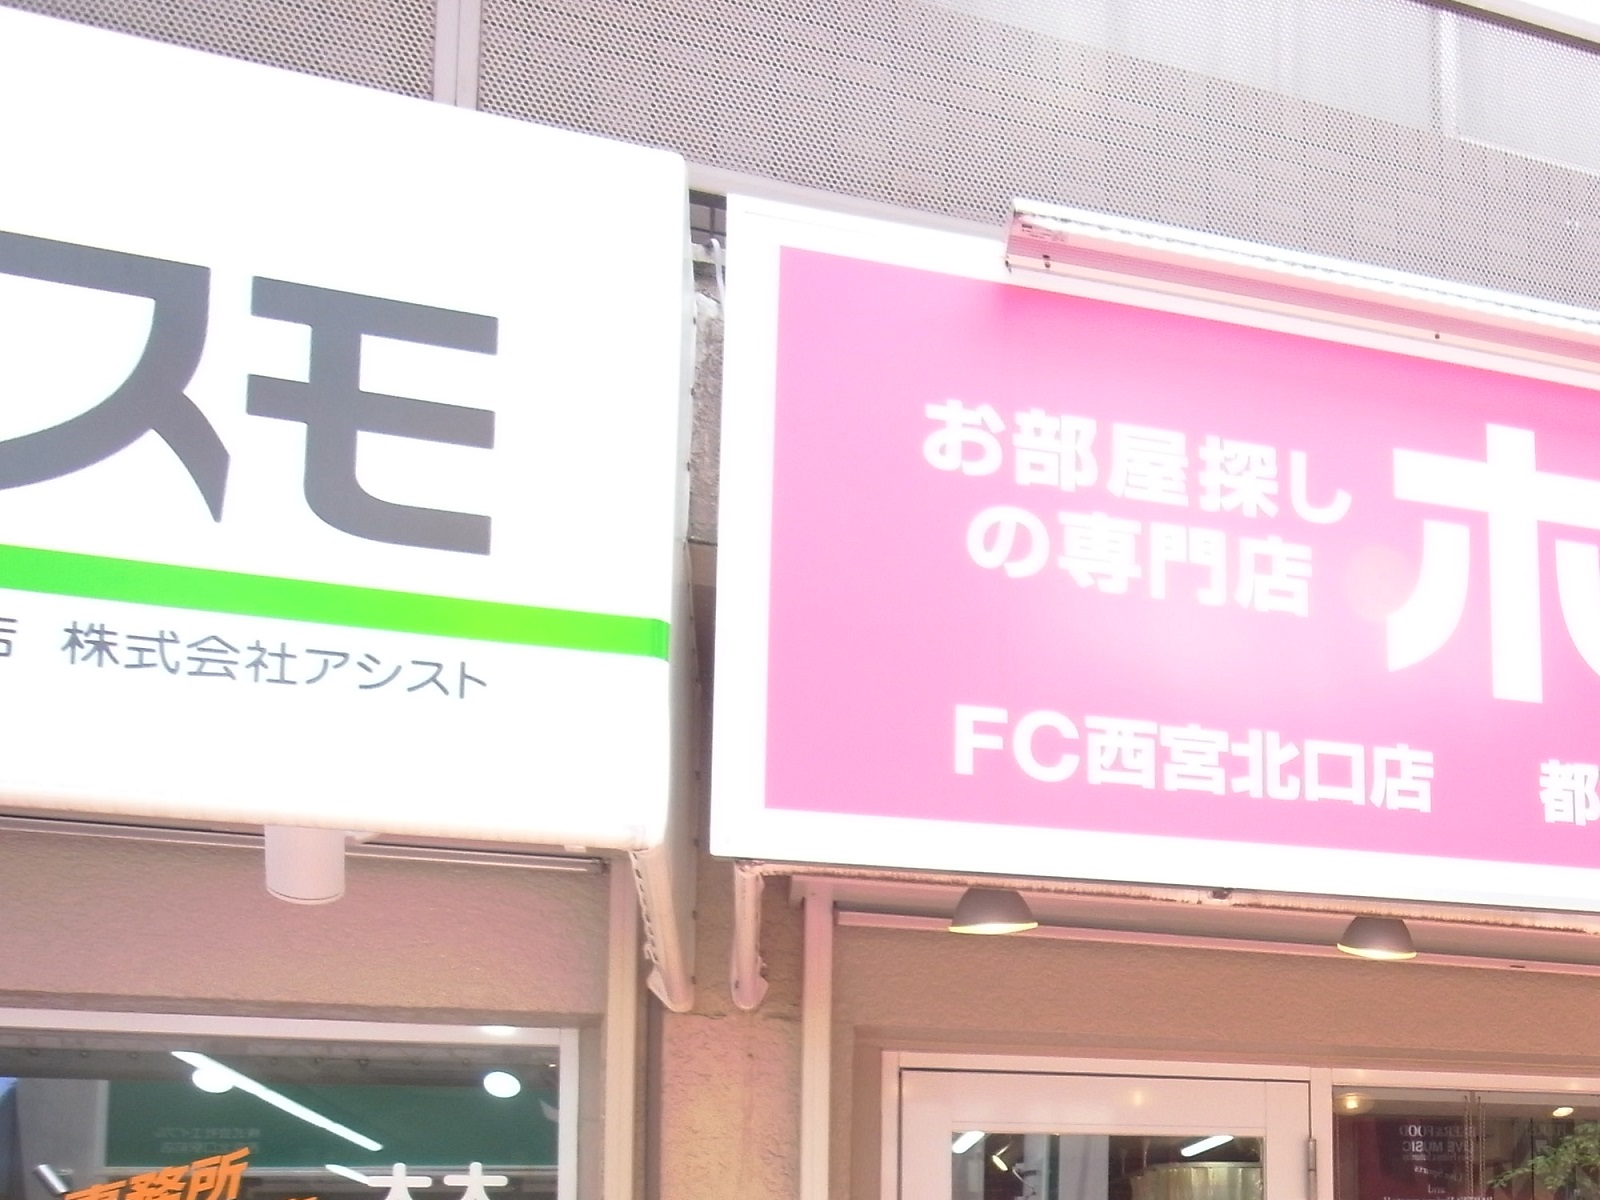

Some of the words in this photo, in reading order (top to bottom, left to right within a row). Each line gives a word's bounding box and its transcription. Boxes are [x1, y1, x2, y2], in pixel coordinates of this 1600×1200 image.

[921, 398, 1352, 526] お部屋探し
[965, 504, 1314, 617] の専門店
[60, 620, 487, 699] 株式会社アシスト
[952, 704, 1435, 814] FC西宮北口店
